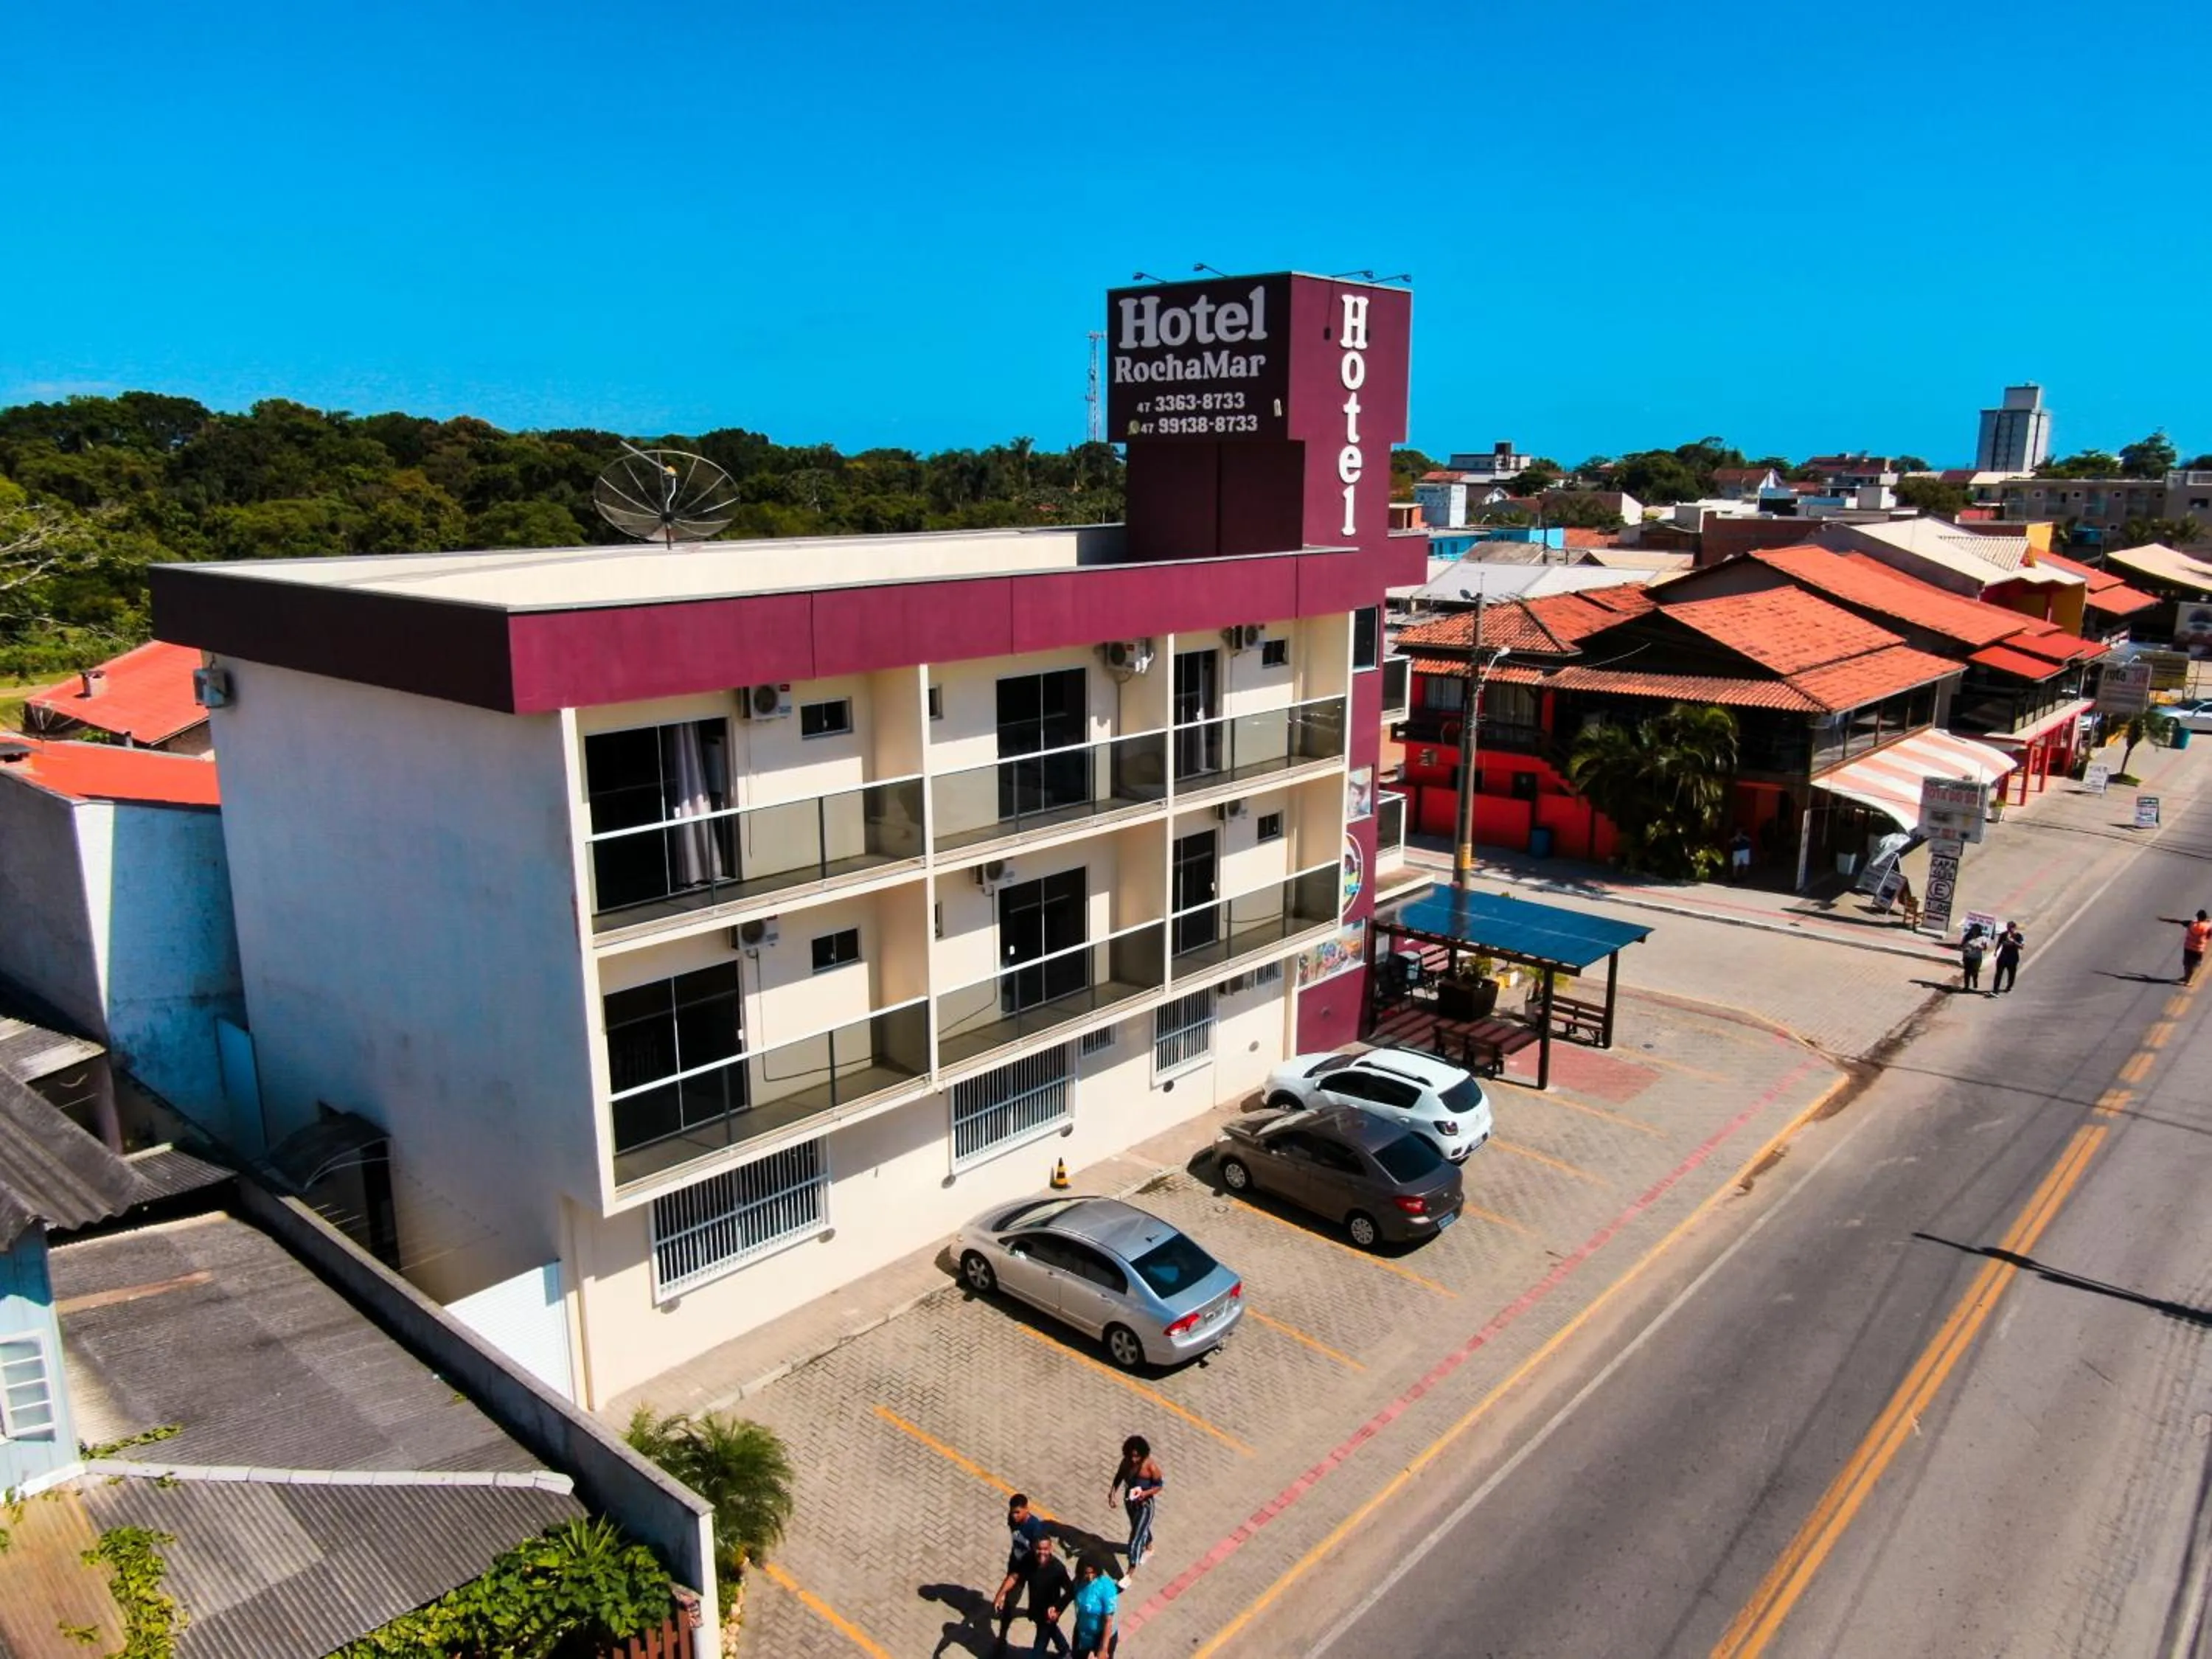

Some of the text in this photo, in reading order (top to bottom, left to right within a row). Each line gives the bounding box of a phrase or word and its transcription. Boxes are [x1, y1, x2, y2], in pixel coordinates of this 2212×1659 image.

[1118, 285, 1268, 349] Hotel
[1114, 349, 1267, 383] RochaMar
[1136, 392, 1245, 413] 47 3363-8733
[1338, 293, 1369, 537] Hotel
[1141, 414, 1258, 434] 47 99138-8733
